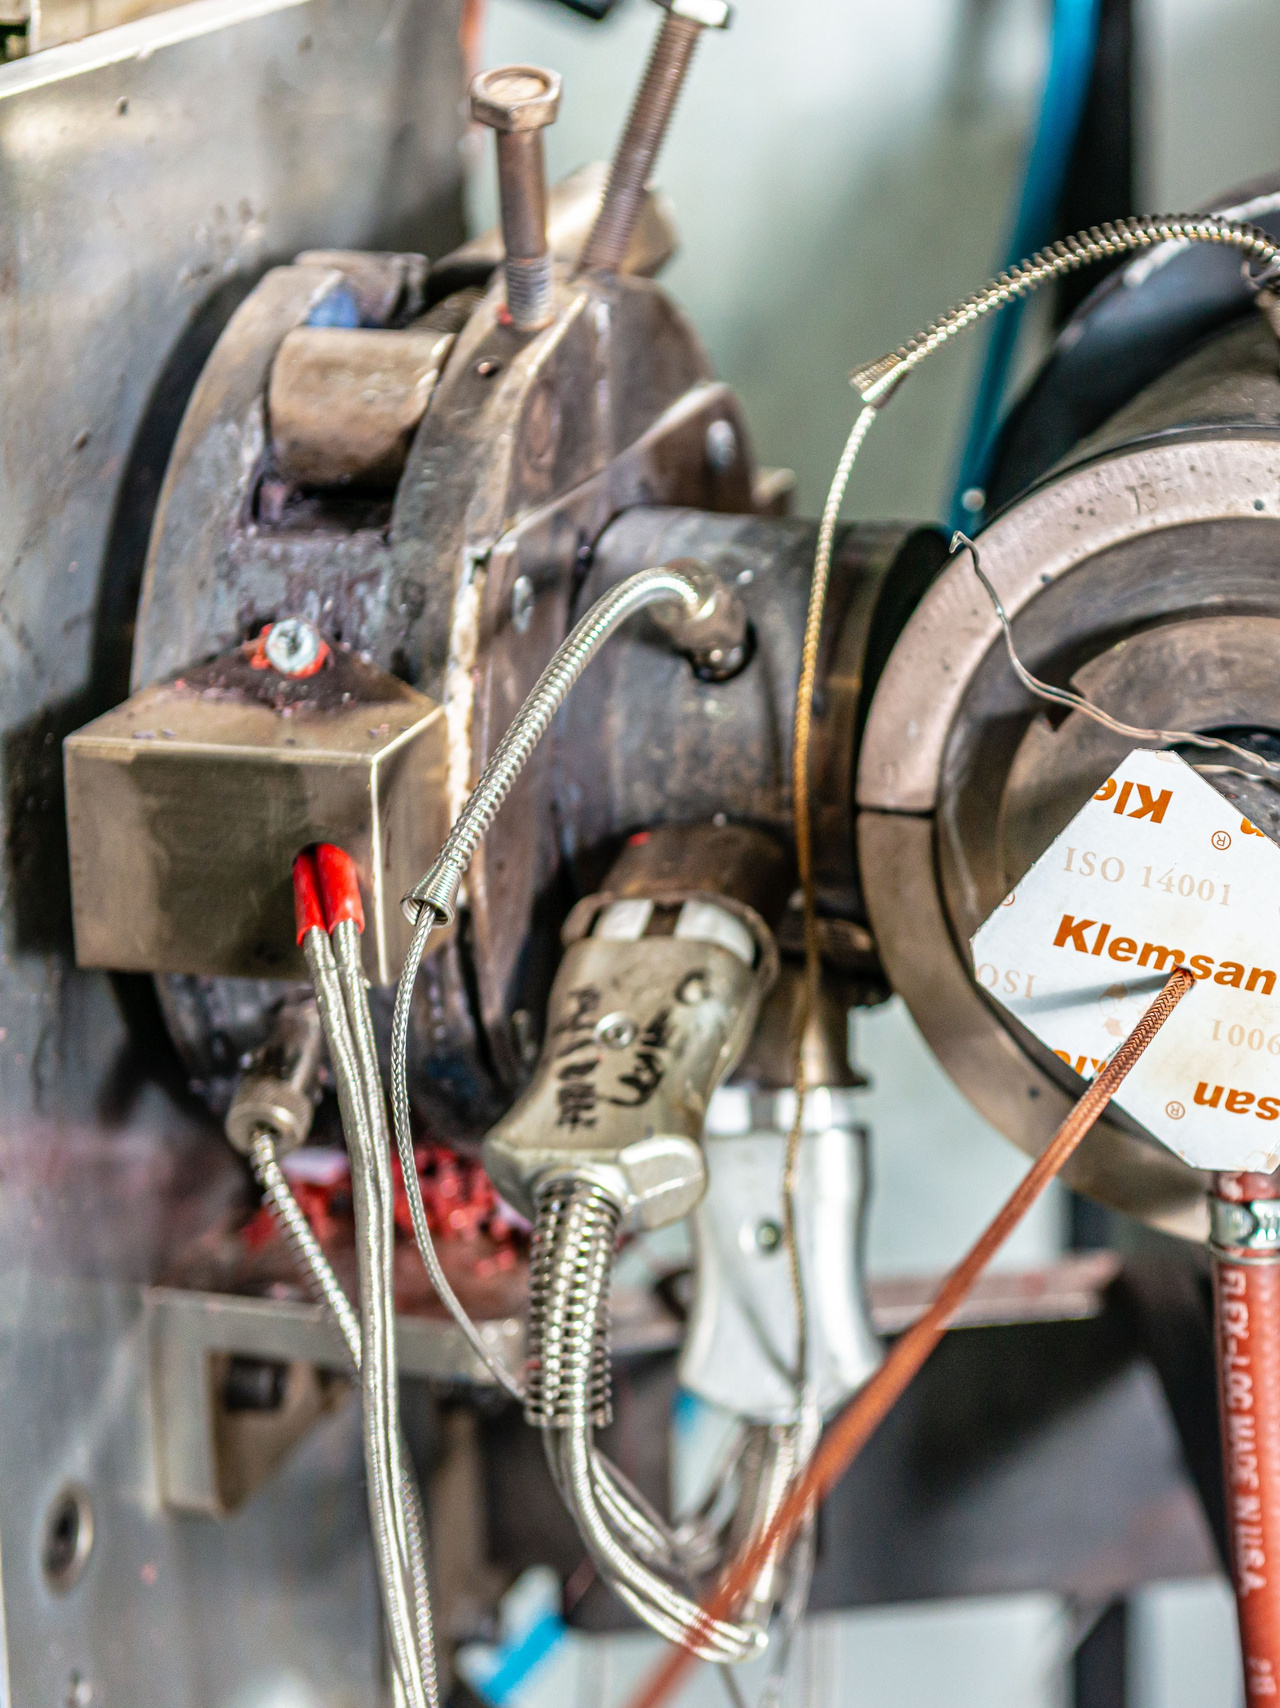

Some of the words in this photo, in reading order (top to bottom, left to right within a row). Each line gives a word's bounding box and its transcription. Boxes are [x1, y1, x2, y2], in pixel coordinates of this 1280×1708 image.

[1063, 846, 1126, 883] ISO
[1142, 866, 1232, 907] 14001
[1053, 914, 1277, 996] Klemsan
